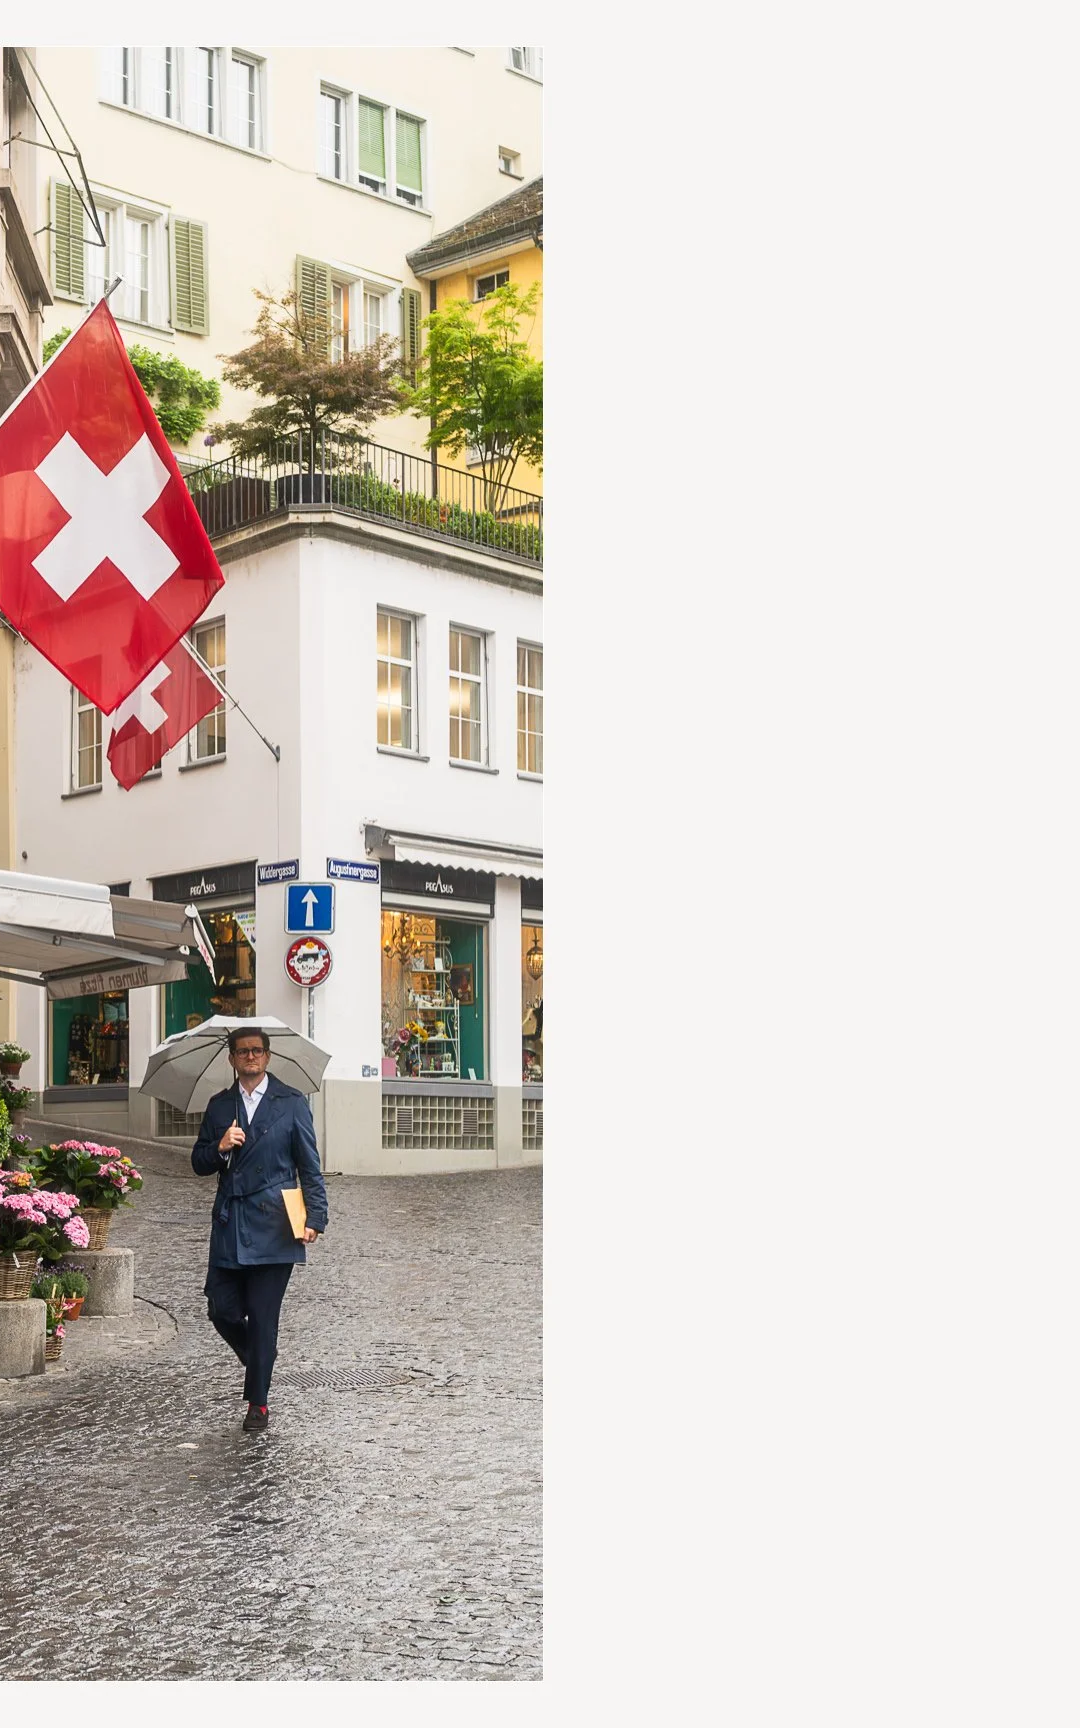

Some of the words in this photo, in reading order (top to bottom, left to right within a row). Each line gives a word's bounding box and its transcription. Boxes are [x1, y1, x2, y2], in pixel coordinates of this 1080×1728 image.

[260, 865, 296, 880] Widdergasse
[330, 860, 377, 880] Augustinergasse
[190, 876, 216, 896] PEGASUS
[425, 872, 454, 895] PEGASUS
